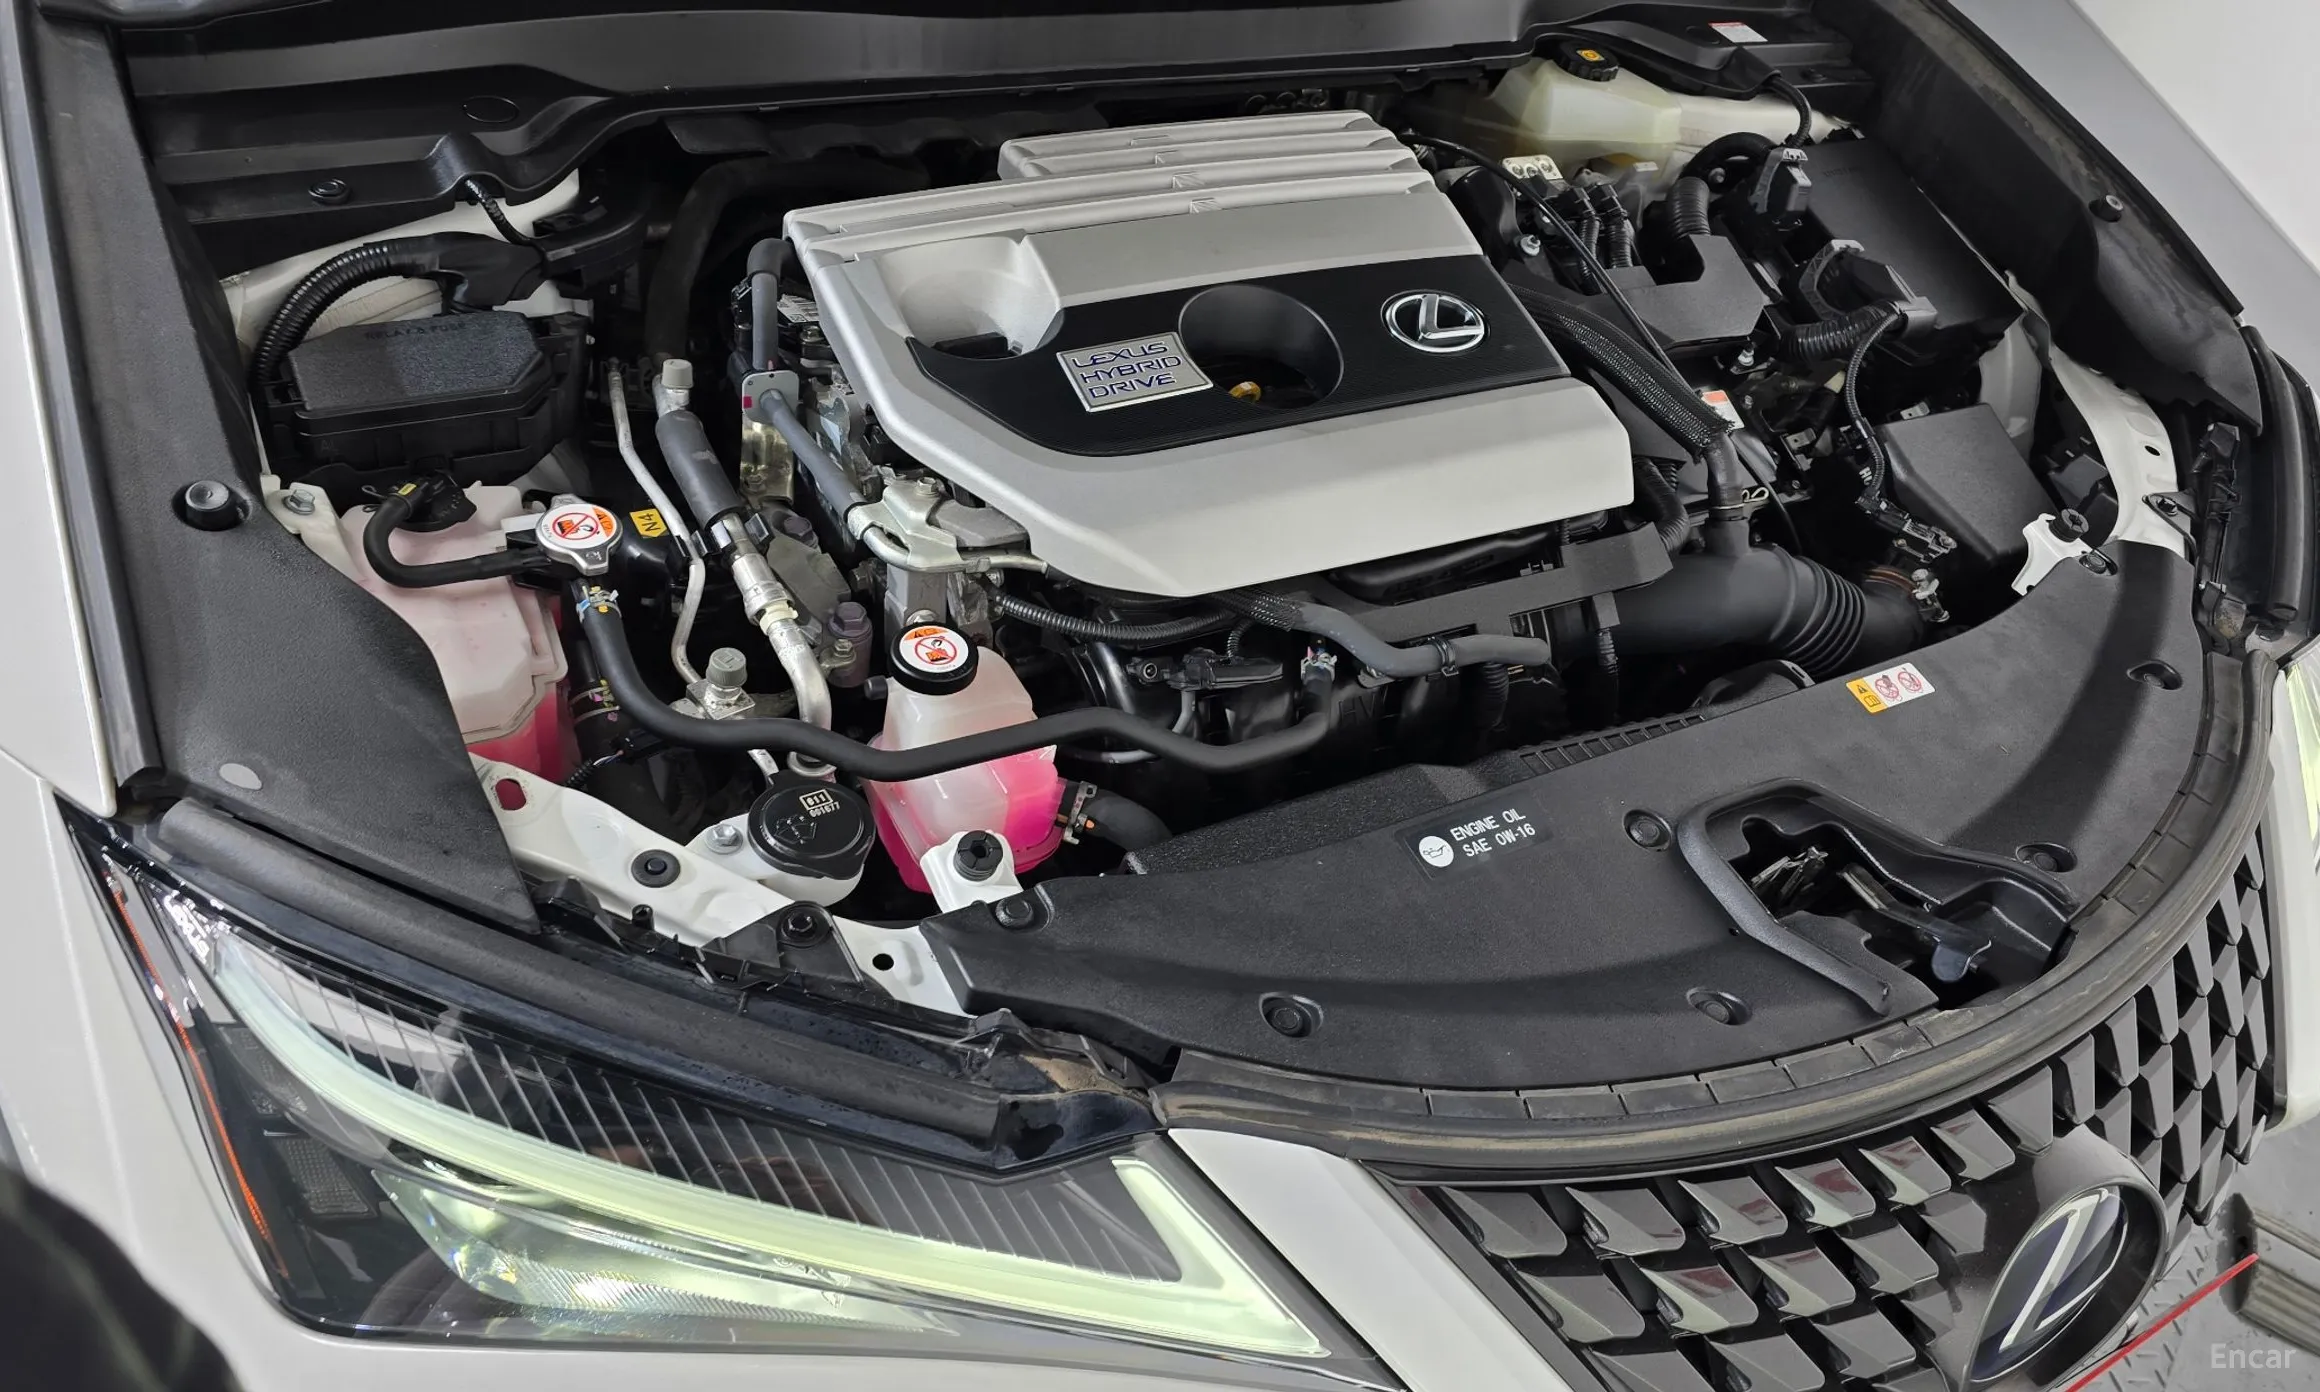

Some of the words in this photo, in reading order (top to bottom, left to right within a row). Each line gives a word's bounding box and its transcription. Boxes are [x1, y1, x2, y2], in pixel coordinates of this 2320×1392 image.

[1072, 341, 1168, 369] LEXUS
[1080, 356, 1182, 384] HYBRID
[1088, 372, 1176, 399] DRIVE
[638, 513, 661, 532] N4
[1450, 815, 1500, 841] ENGINE
[1502, 808, 1526, 824] OIL
[1462, 838, 1493, 857] SAE
[1495, 823, 1536, 846] 0W-16
